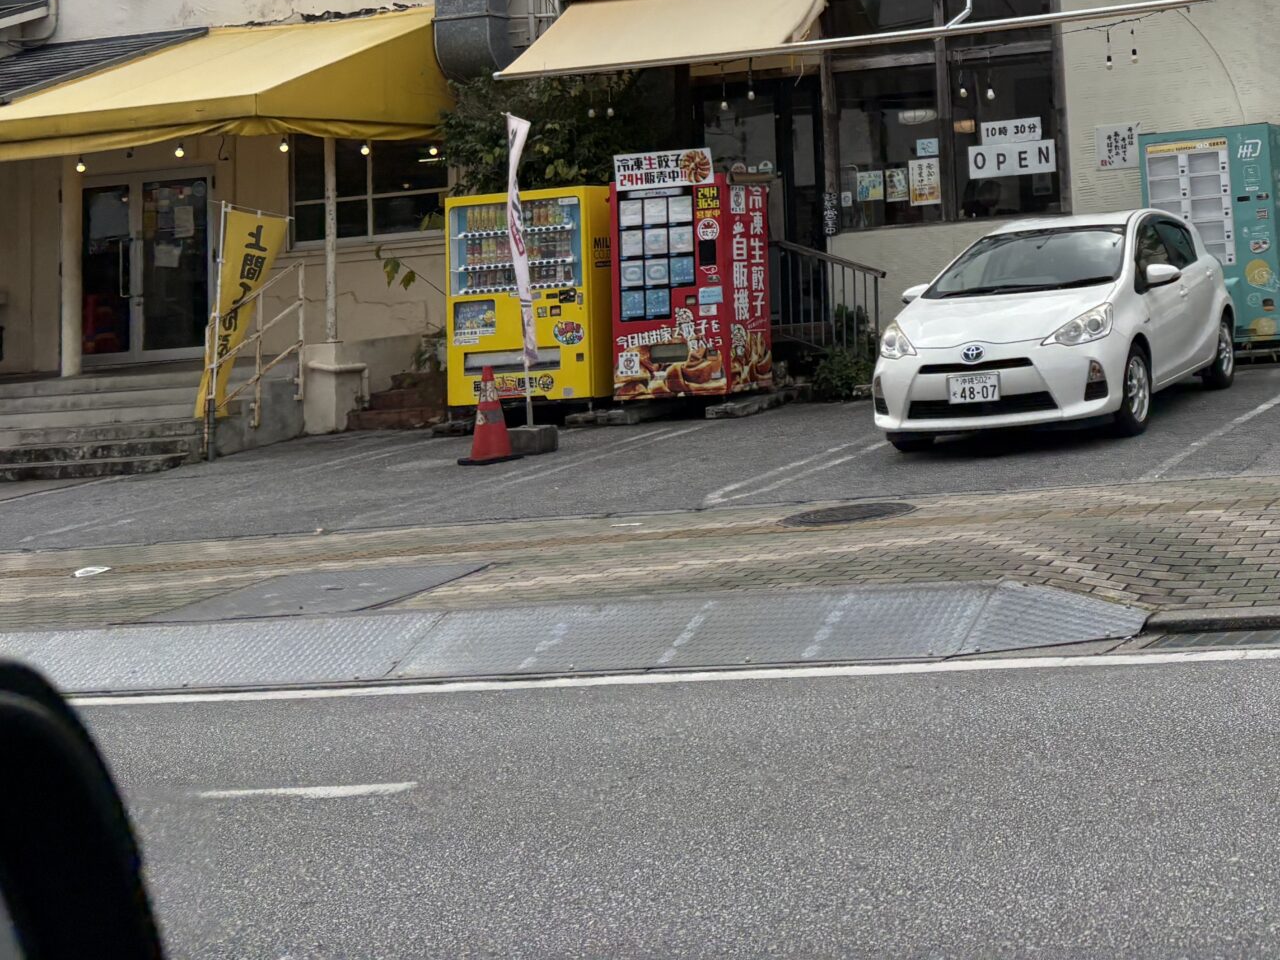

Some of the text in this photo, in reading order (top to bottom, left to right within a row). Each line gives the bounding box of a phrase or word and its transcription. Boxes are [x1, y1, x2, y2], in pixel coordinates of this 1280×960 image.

[985, 123, 1038, 138] 10時 30分
[616, 152, 684, 173] 冷凍生餃子
[973, 145, 1050, 171] OPEN
[697, 187, 718, 199] 24H
[749, 185, 766, 317] 冷凍生餃子
[732, 235, 749, 320] 自販機
[960, 385, 997, 401] 48-07
